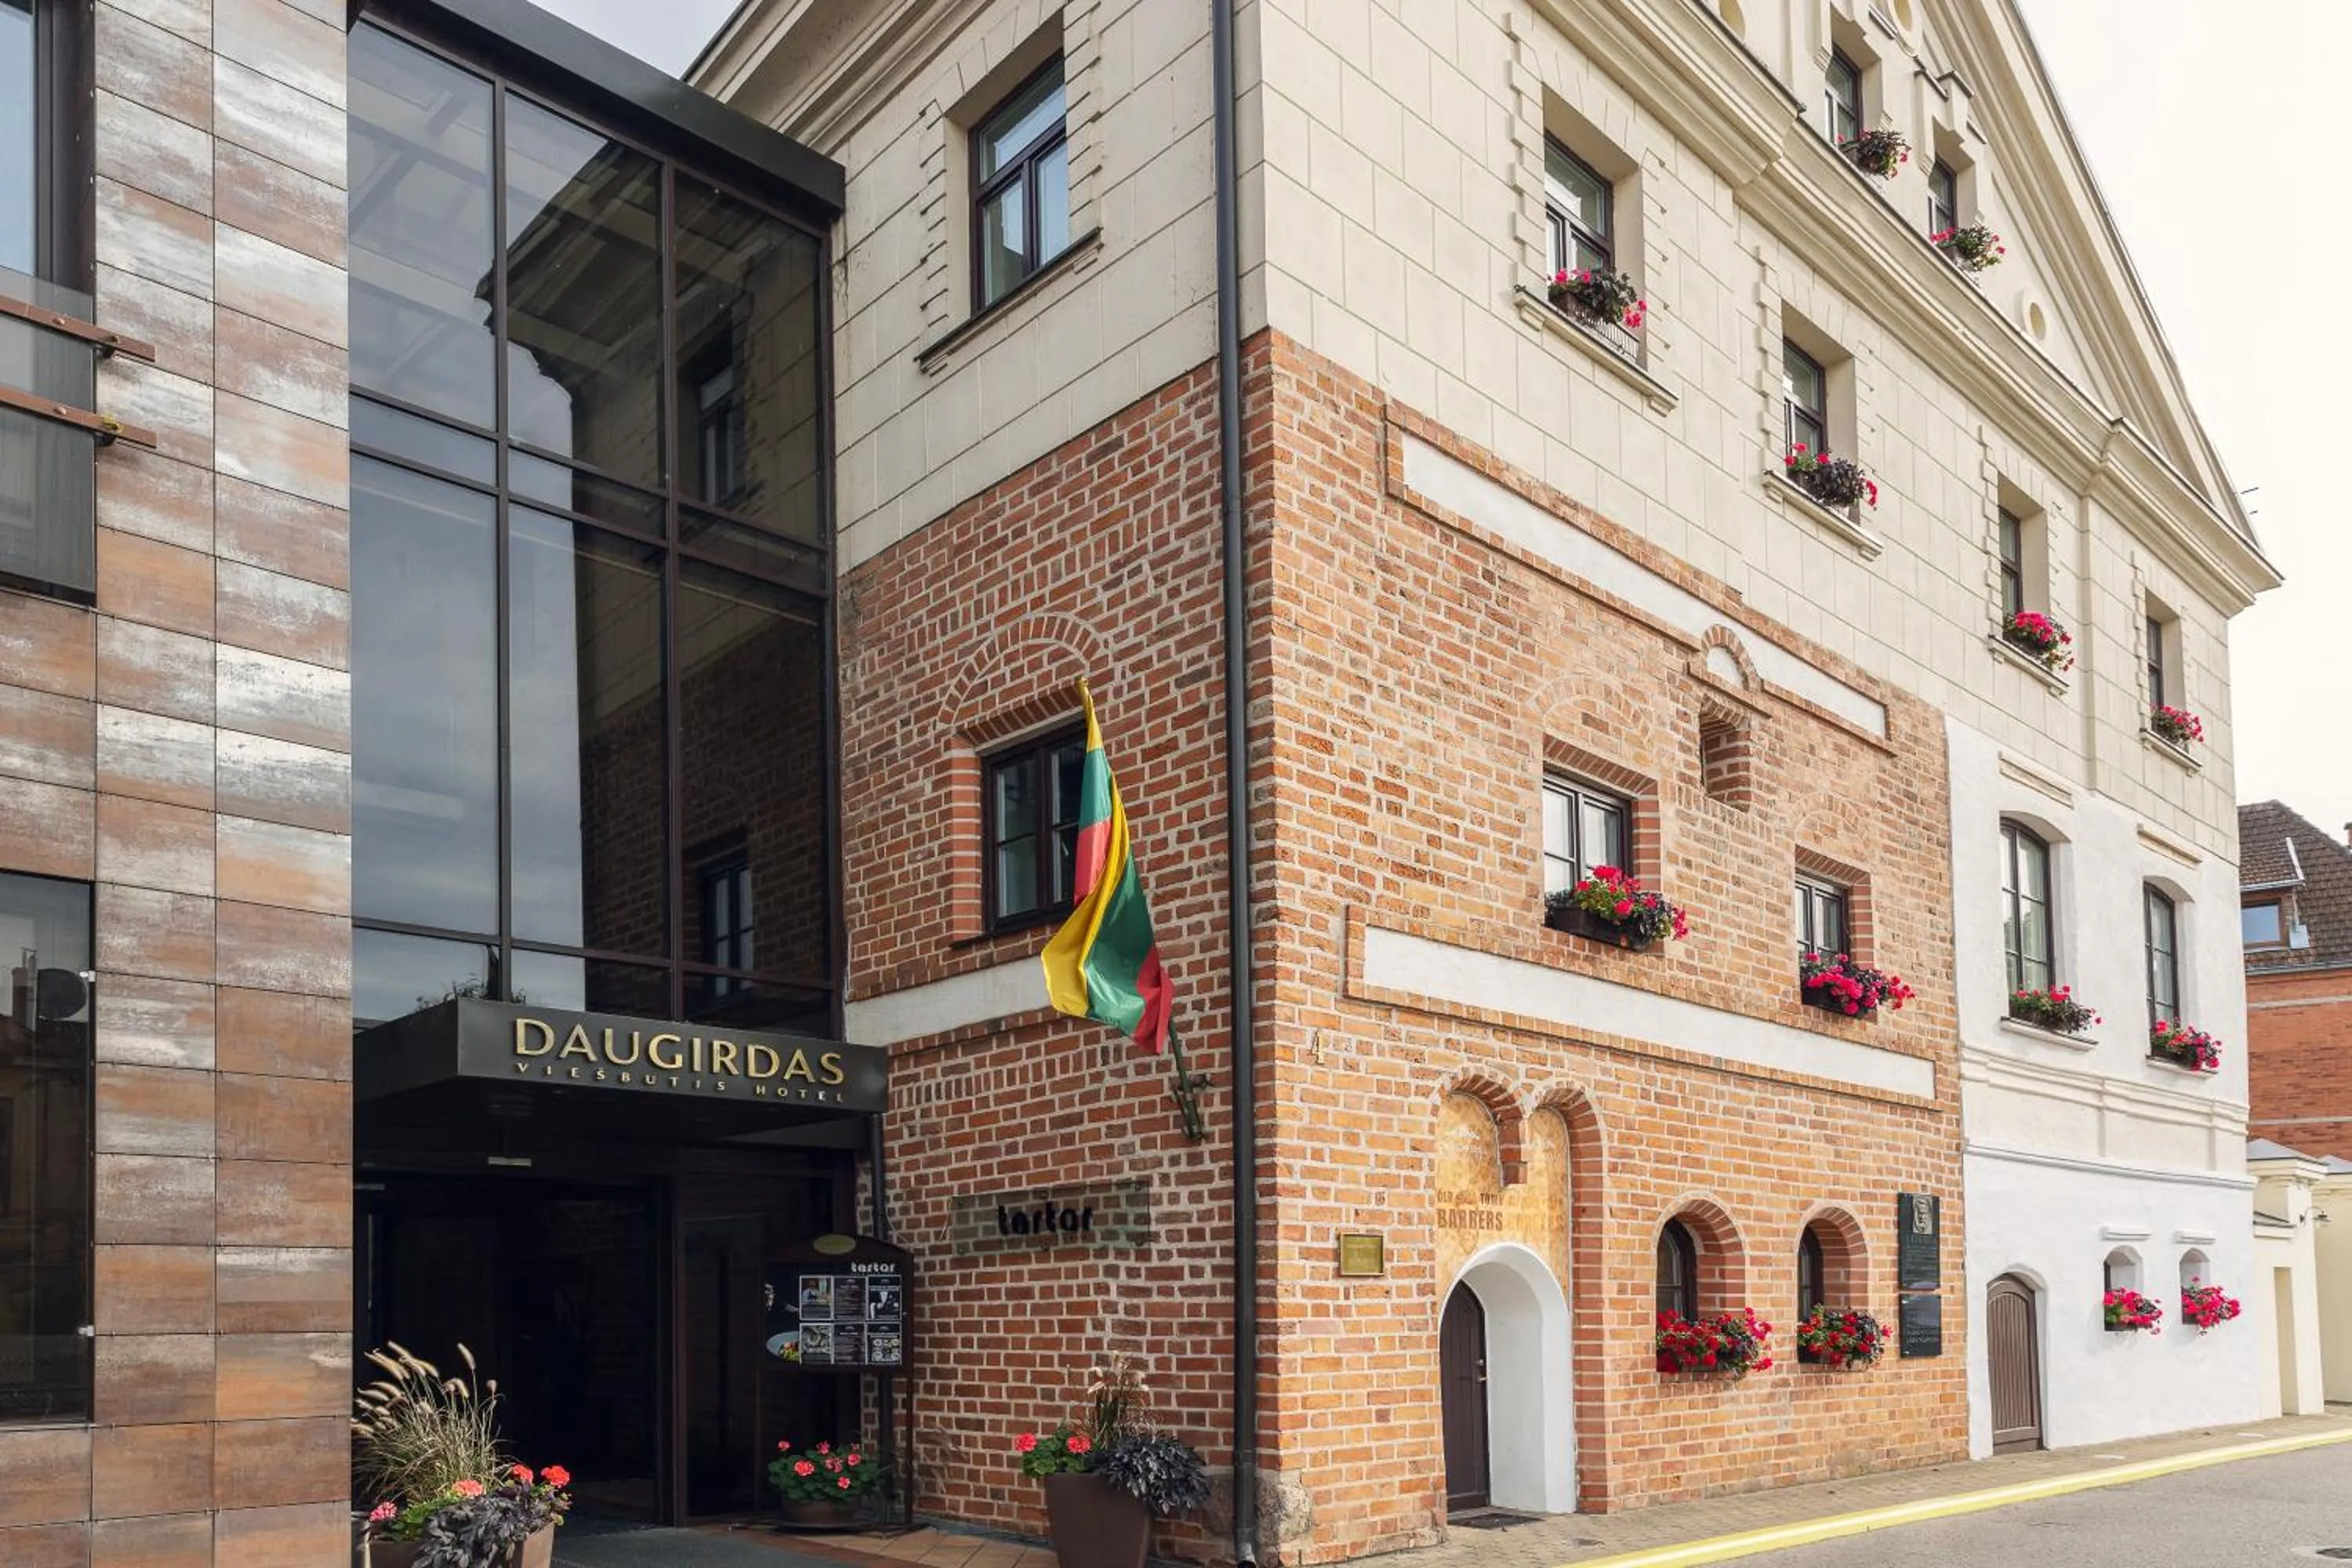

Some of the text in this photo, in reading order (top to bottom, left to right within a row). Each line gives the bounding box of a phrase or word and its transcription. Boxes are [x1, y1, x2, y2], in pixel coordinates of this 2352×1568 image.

[514, 1018, 845, 1086] DAUGIRDAS
[516, 1062, 844, 1104] VIEŠBUTIS HOTEL
[1437, 1208, 1504, 1231] BARBERS
[851, 1261, 895, 1272] tartar
